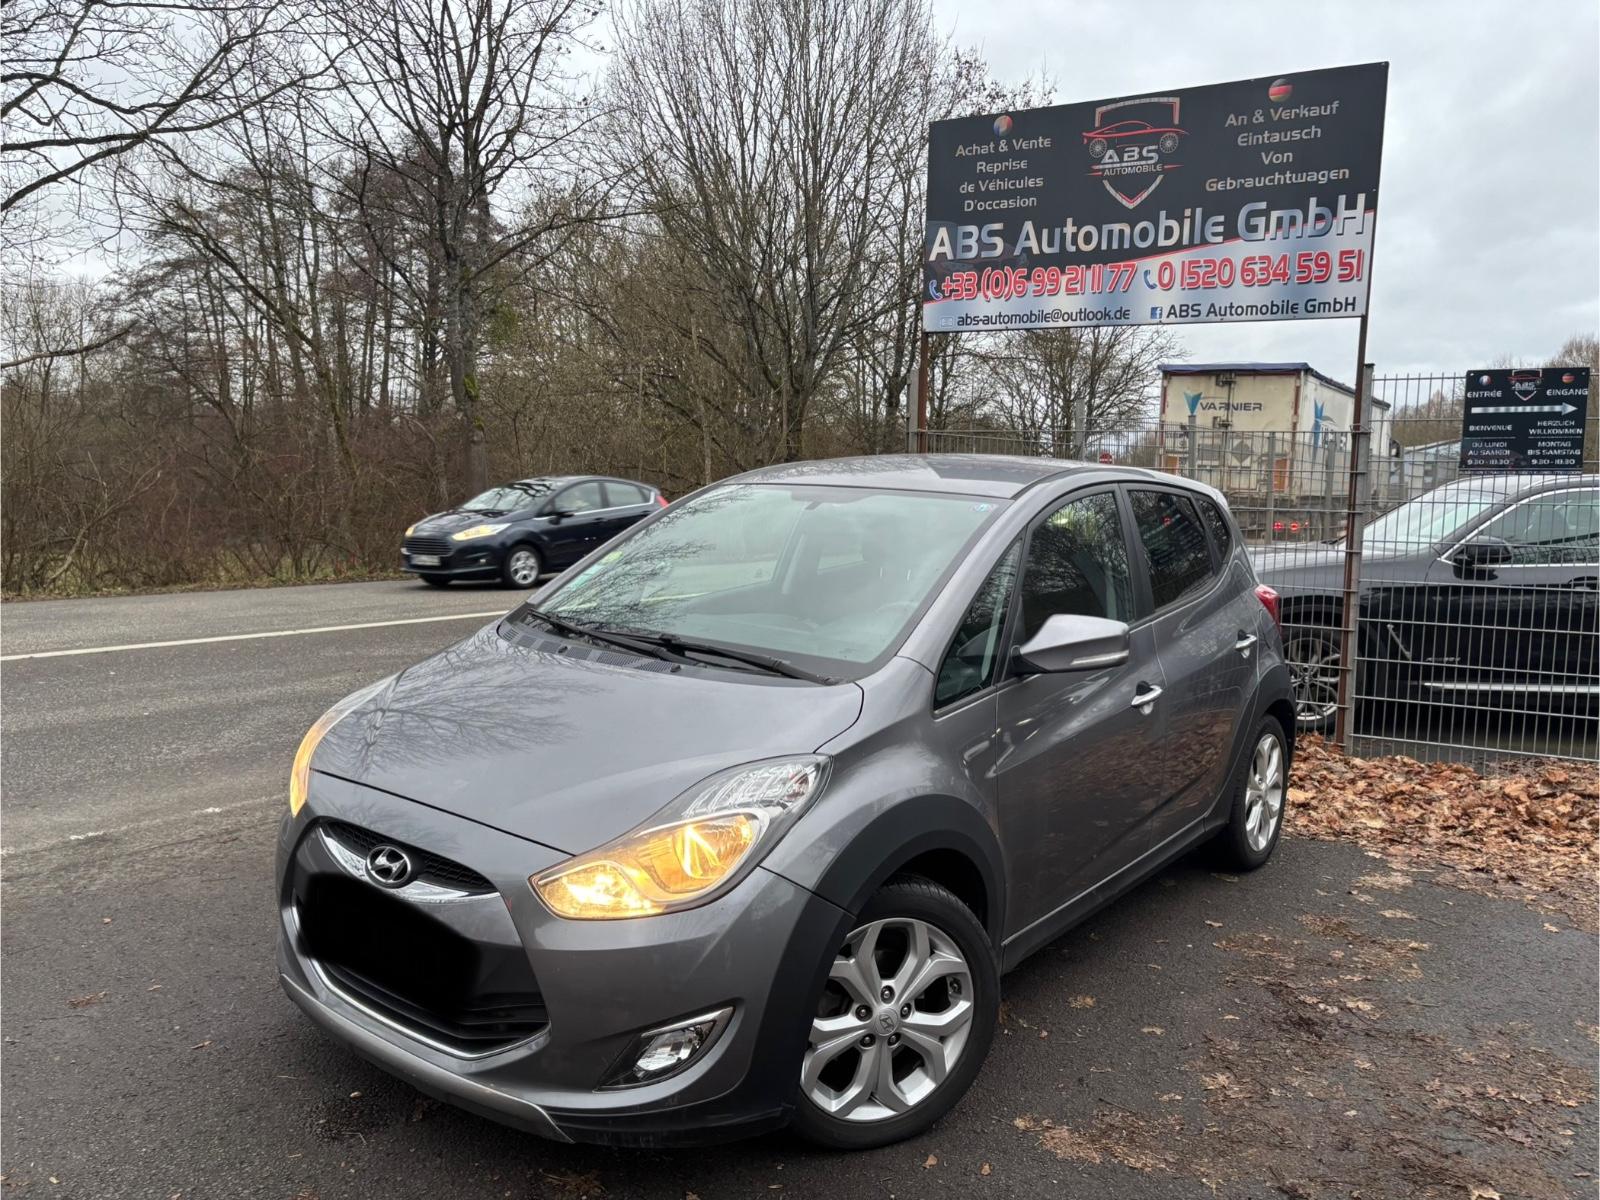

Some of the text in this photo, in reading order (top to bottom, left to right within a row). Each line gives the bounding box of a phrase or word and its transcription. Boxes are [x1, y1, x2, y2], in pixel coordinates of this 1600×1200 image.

[1225, 100, 1340, 127] An & Verkauf
[1237, 125, 1322, 146] Eintausch
[955, 136, 1052, 157] Achat & Vente
[1100, 145, 1159, 164] ABS
[976, 158, 1028, 174] Reprise
[1261, 151, 1293, 165] Von
[959, 176, 1044, 194] de Véhicules
[1205, 168, 1350, 192] Gebrauchtwagen
[964, 196, 1037, 211] D'occasion
[929, 193, 1367, 262] ABS Automobile GmbH
[1157, 249, 1364, 290] 0 1520 634 59 51
[941, 271, 978, 300] +33
[981, 266, 1028, 301] (0)6
[1031, 267, 1061, 295] 99
[1065, 265, 1086, 294] 21
[1107, 262, 1137, 293] 77
[957, 306, 1131, 326] abs-automobile@outlook.de
[1166, 303, 1202, 319] ABS
[1206, 299, 1299, 317] Automobile
[1304, 296, 1357, 313] GmbH
[1466, 389, 1503, 398] ENTRÉE
[1546, 388, 1589, 396] EINGANG
[1200, 402, 1263, 412] VARNIER
[1468, 424, 1513, 432] BIENVENUE
